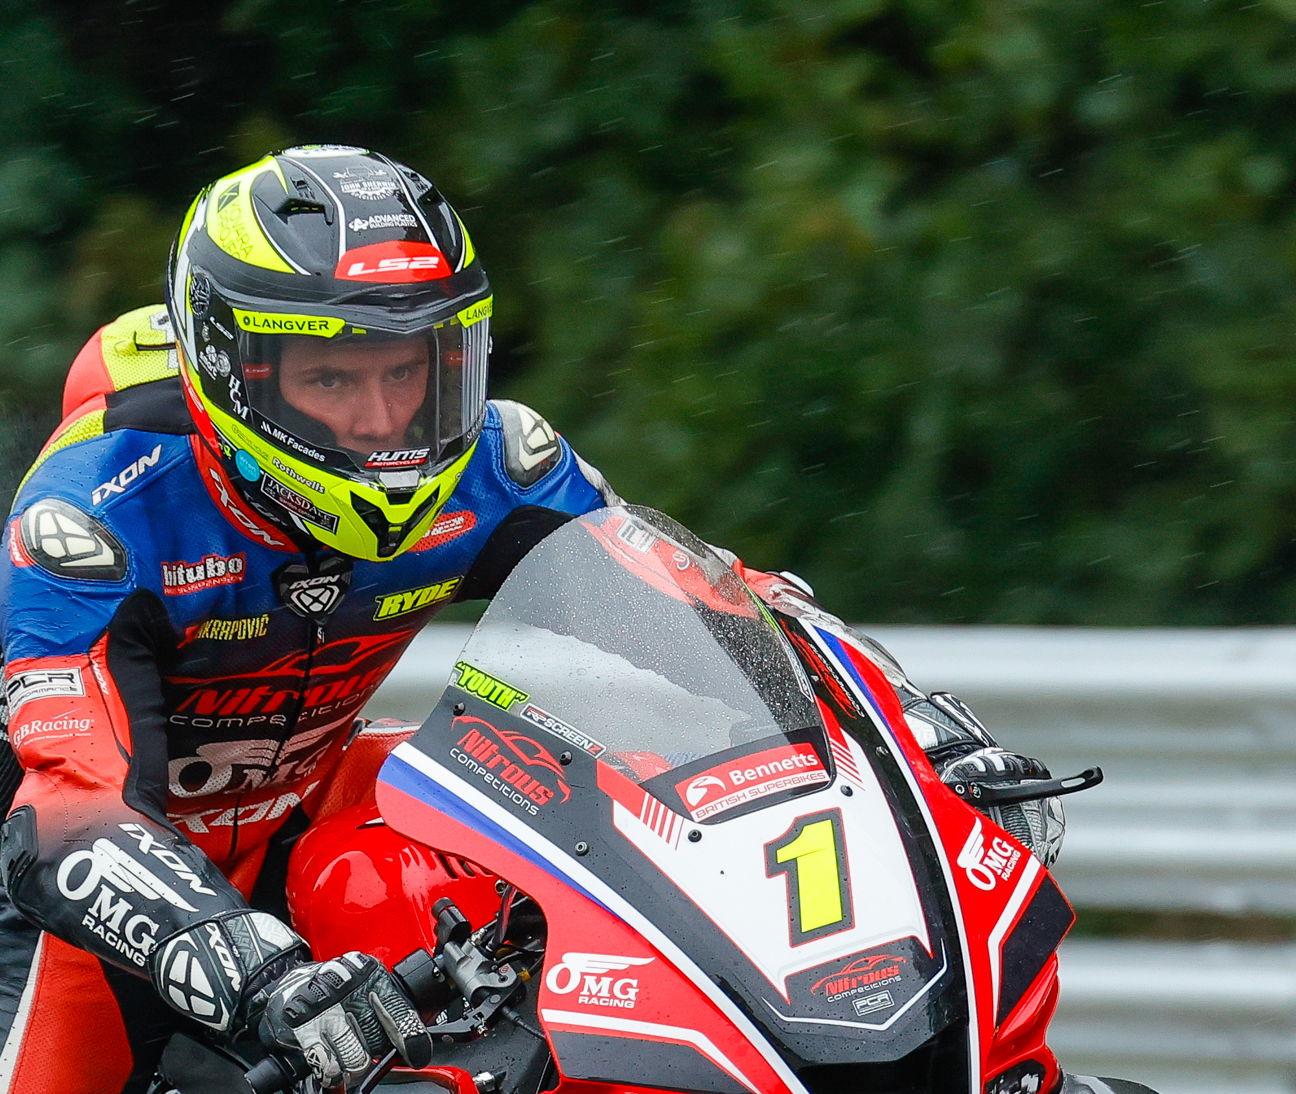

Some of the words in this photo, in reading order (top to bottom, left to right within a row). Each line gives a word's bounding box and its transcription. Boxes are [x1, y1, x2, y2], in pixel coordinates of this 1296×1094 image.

[368, 214, 416, 224] ADVANCED
[347, 256, 439, 276] LS2
[252, 316, 330, 333] LANGVER
[272, 428, 287, 444] MK
[286, 436, 326, 462] Facades
[367, 447, 431, 462] HUNTS
[91, 444, 162, 506] IXON
[272, 458, 325, 494] Rothwells
[209, 468, 285, 546] IXON
[163, 557, 243, 587] bitubo
[289, 574, 340, 590] IXON
[377, 578, 461, 618] RYDE
[728, 753, 819, 786] Bennetts
[166, 779, 321, 833] XON
[695, 791, 748, 819] BRITISH
[747, 771, 827, 798] SUPERBIKES
[118, 823, 218, 897] IXON
[772, 816, 846, 936] 1
[961, 831, 1015, 891] OMG
[1000, 849, 1021, 882] RACING
[81, 914, 146, 968] RACING
[545, 953, 640, 1000] OMG
[578, 996, 636, 1009] RACING
